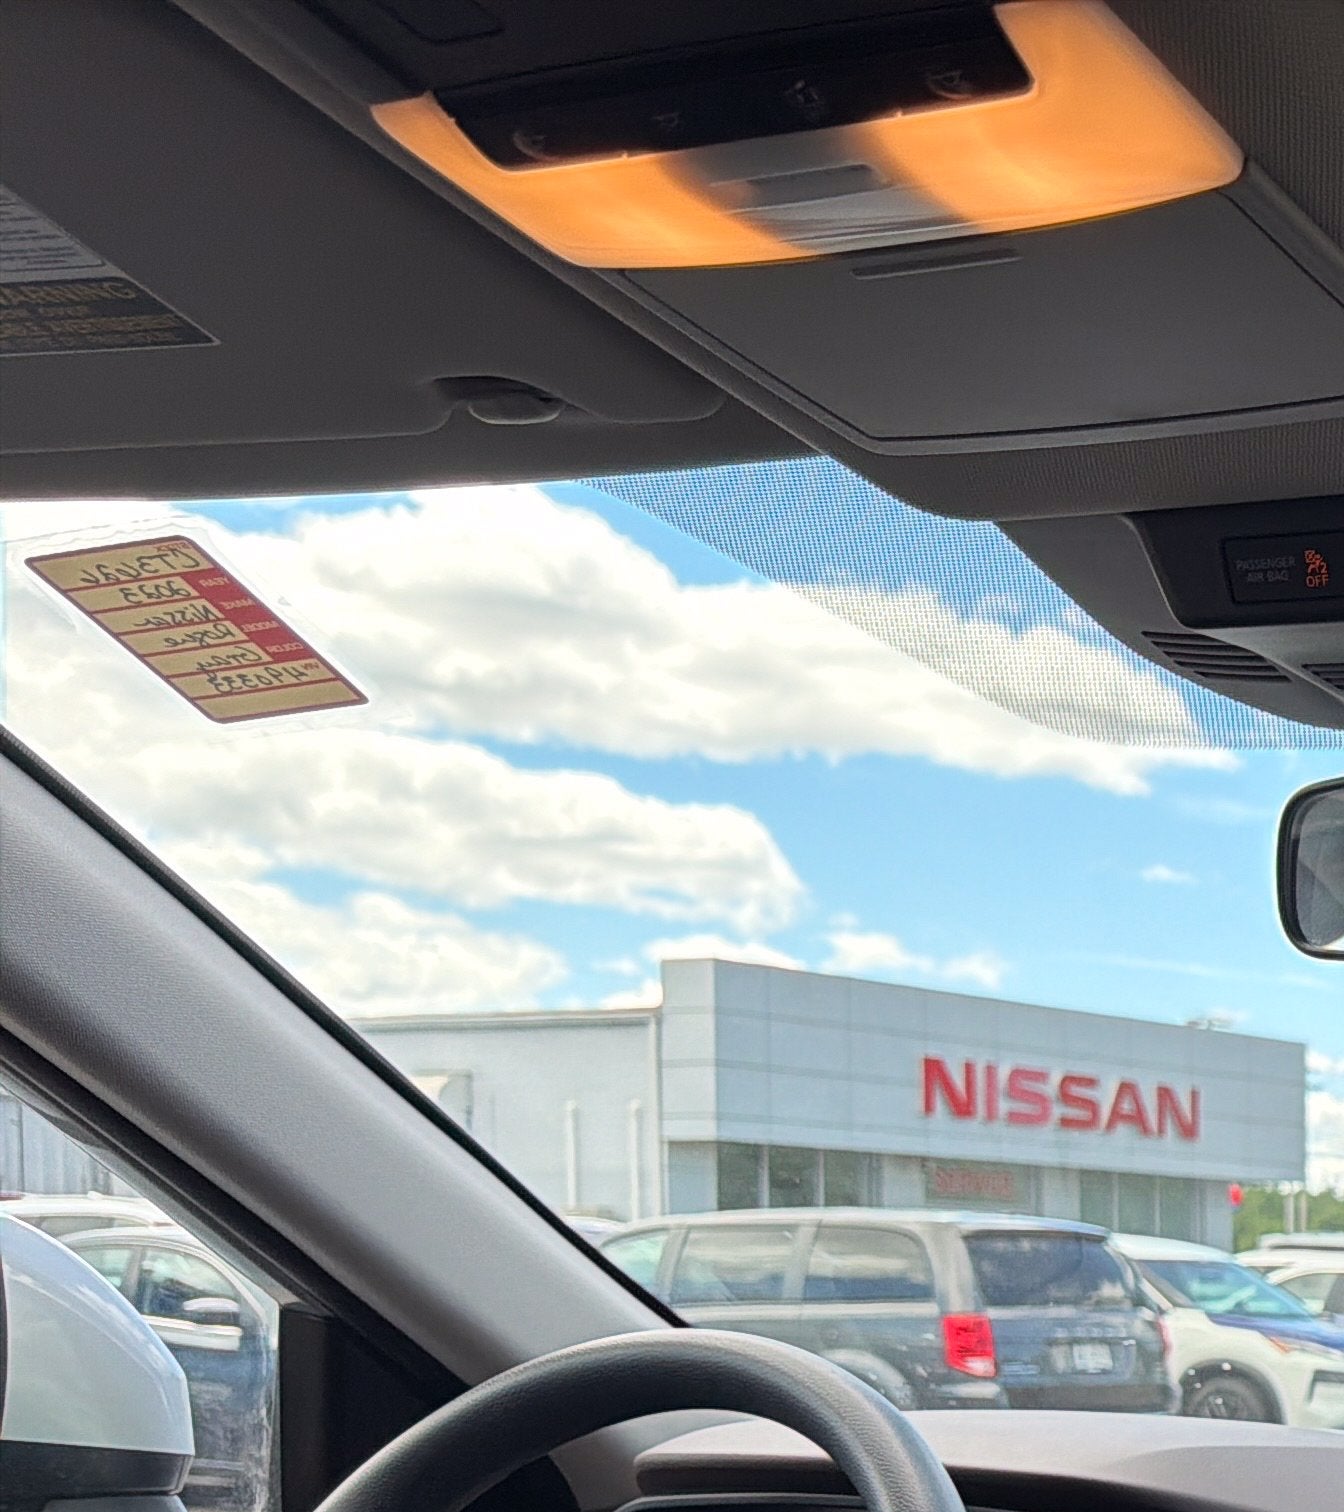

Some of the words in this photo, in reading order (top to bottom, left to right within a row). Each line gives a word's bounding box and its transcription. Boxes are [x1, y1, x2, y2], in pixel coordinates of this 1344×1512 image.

[1235, 556, 1297, 571] PASSENGER
[1306, 574, 1329, 588] OFF
[921, 1055, 1202, 1142] NISSAN
